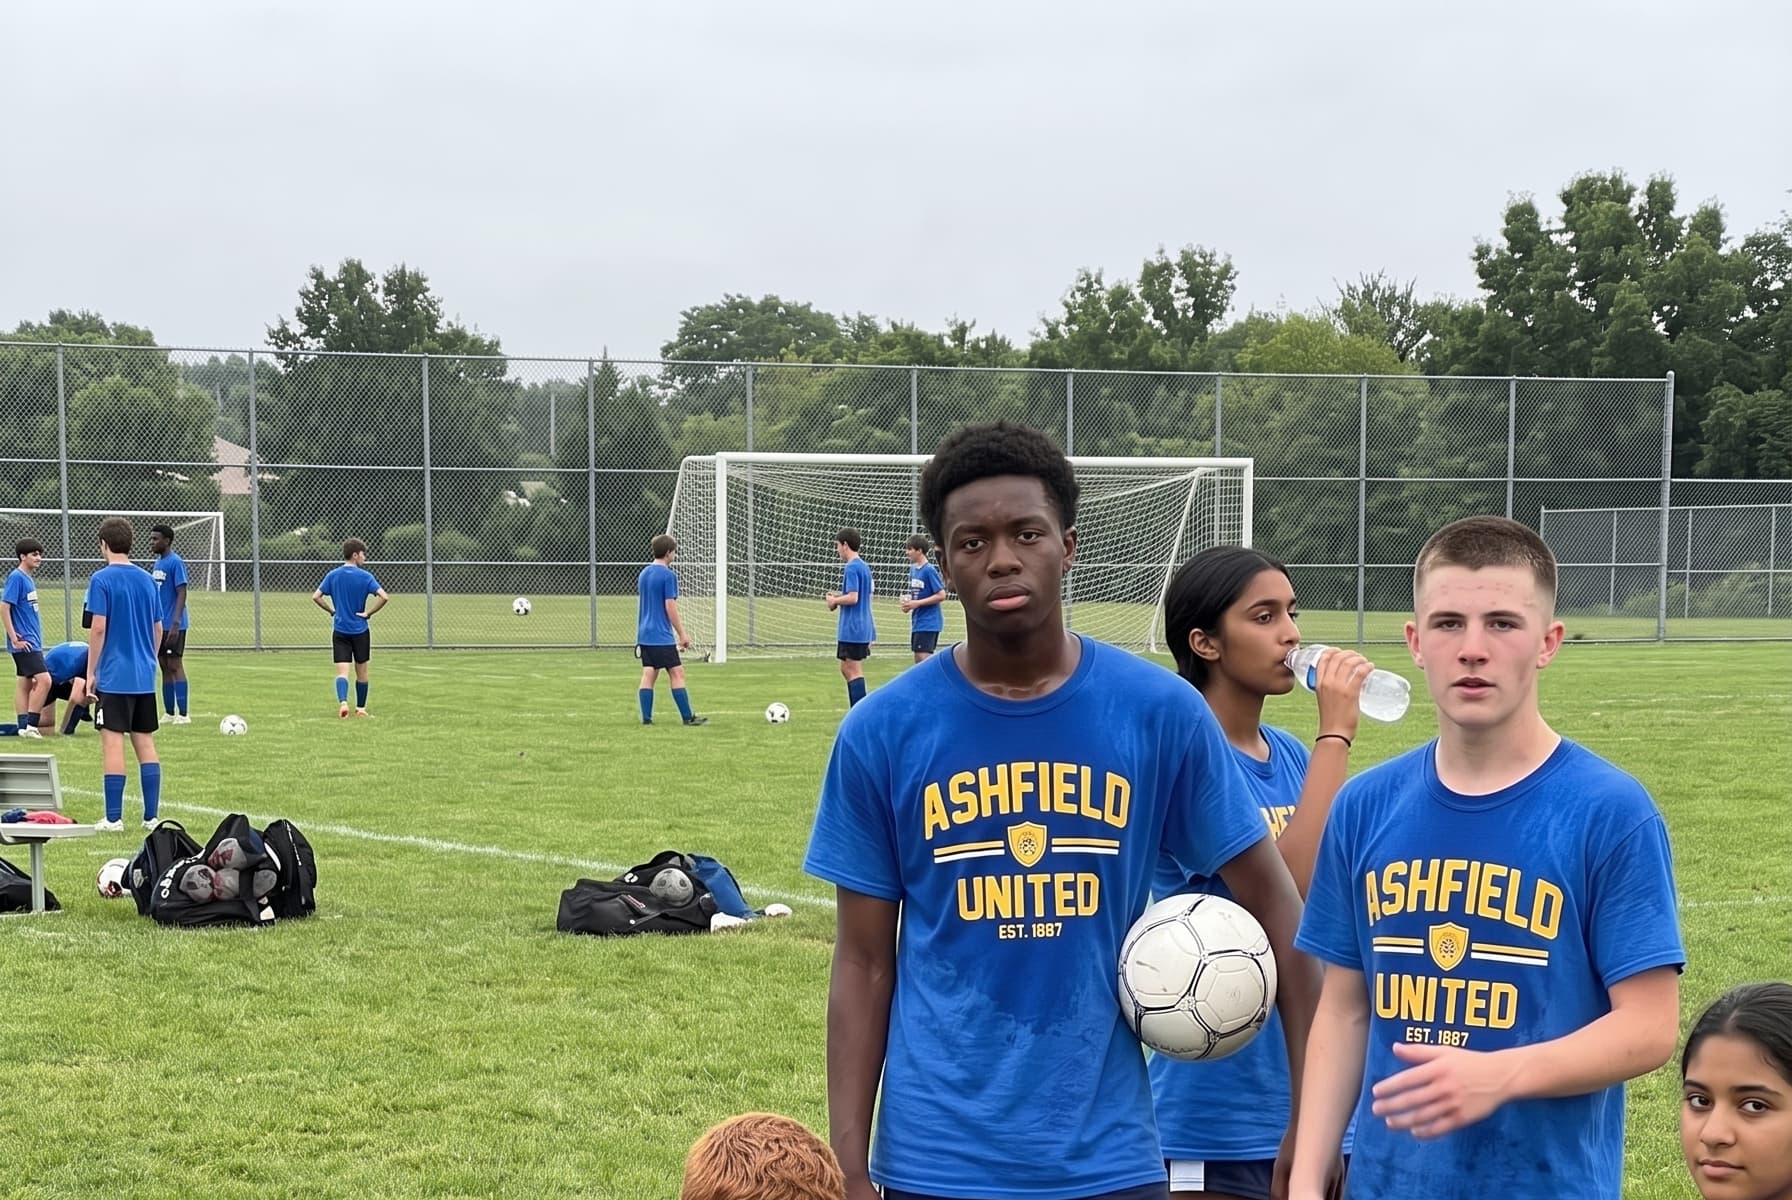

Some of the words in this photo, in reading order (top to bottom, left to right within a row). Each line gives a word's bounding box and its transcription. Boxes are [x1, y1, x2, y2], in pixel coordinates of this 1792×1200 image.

[924, 762, 1131, 840] ASHFIELD
[957, 872, 1100, 921] UNITED
[1365, 858, 1564, 940] ASHFIELD
[998, 923, 1029, 940] EST.
[1031, 922, 1063, 938] 1887
[1375, 972, 1519, 1029] UNITED
[1405, 1026, 1434, 1044] EST.
[1437, 1029, 1469, 1047] 1887
